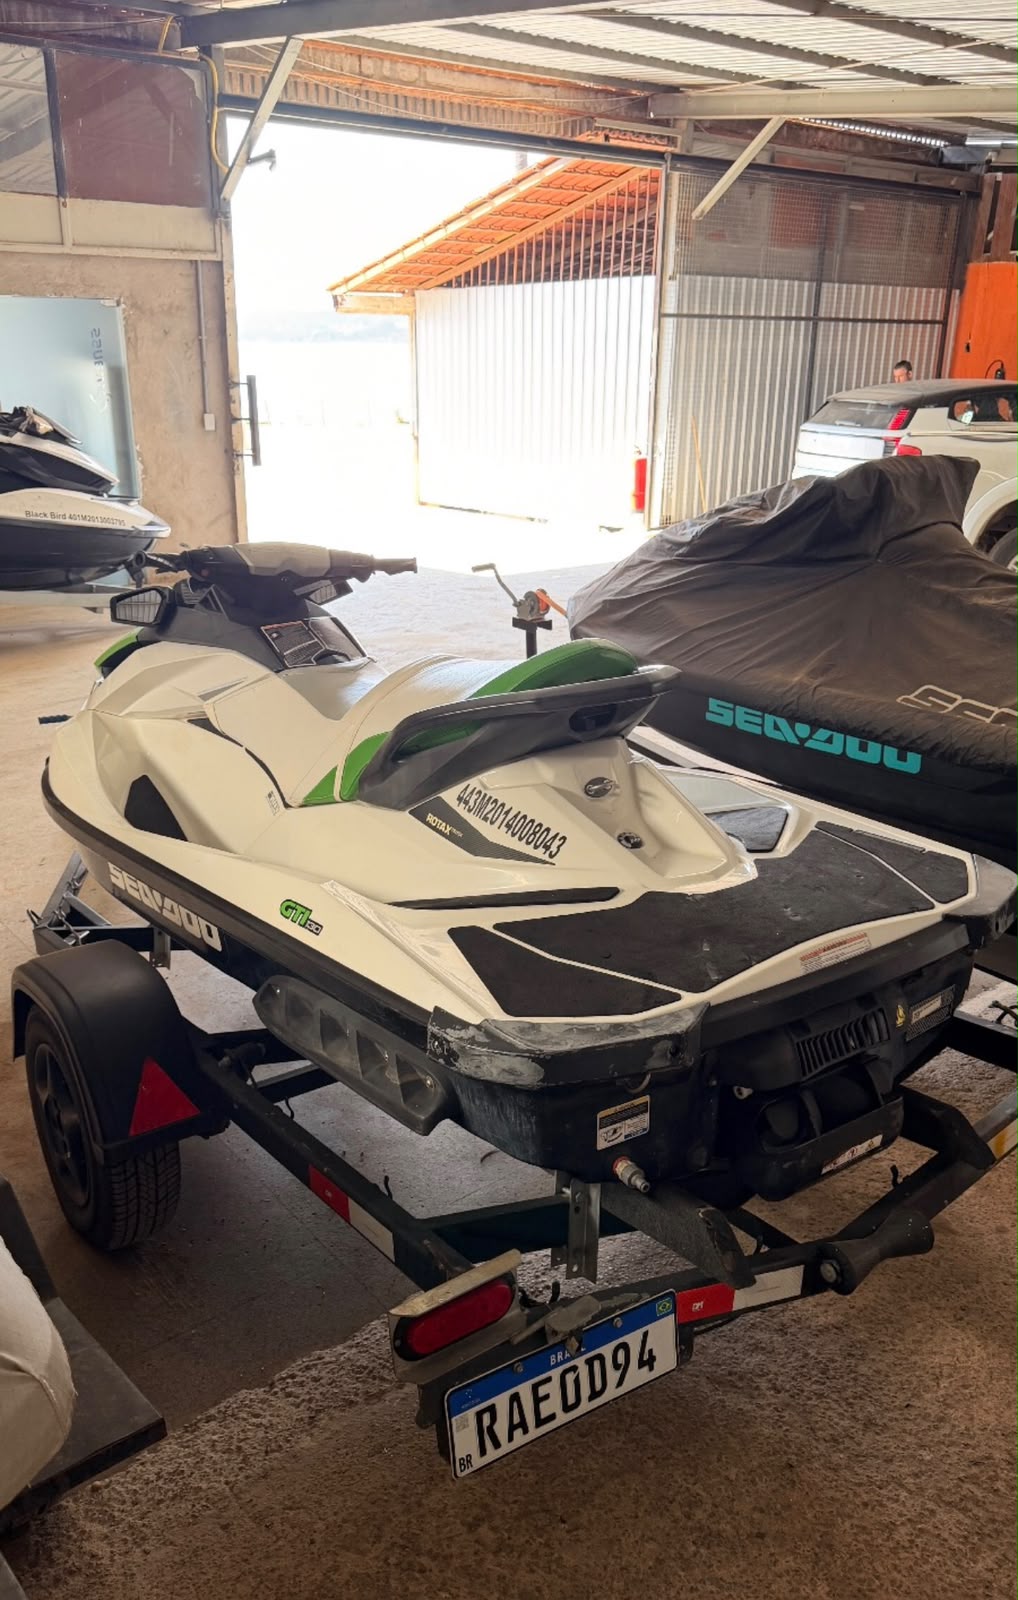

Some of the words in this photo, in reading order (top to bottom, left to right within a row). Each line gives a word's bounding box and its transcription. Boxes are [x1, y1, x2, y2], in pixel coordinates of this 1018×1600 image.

[25, 510, 48, 519] Black
[50, 511, 66, 520] Bird
[426, 812, 450, 836] ROTAX
[456, 784, 568, 859] 443M2014008043
[550, 1347, 587, 1366] BRAL
[458, 1453, 473, 1473] BR
